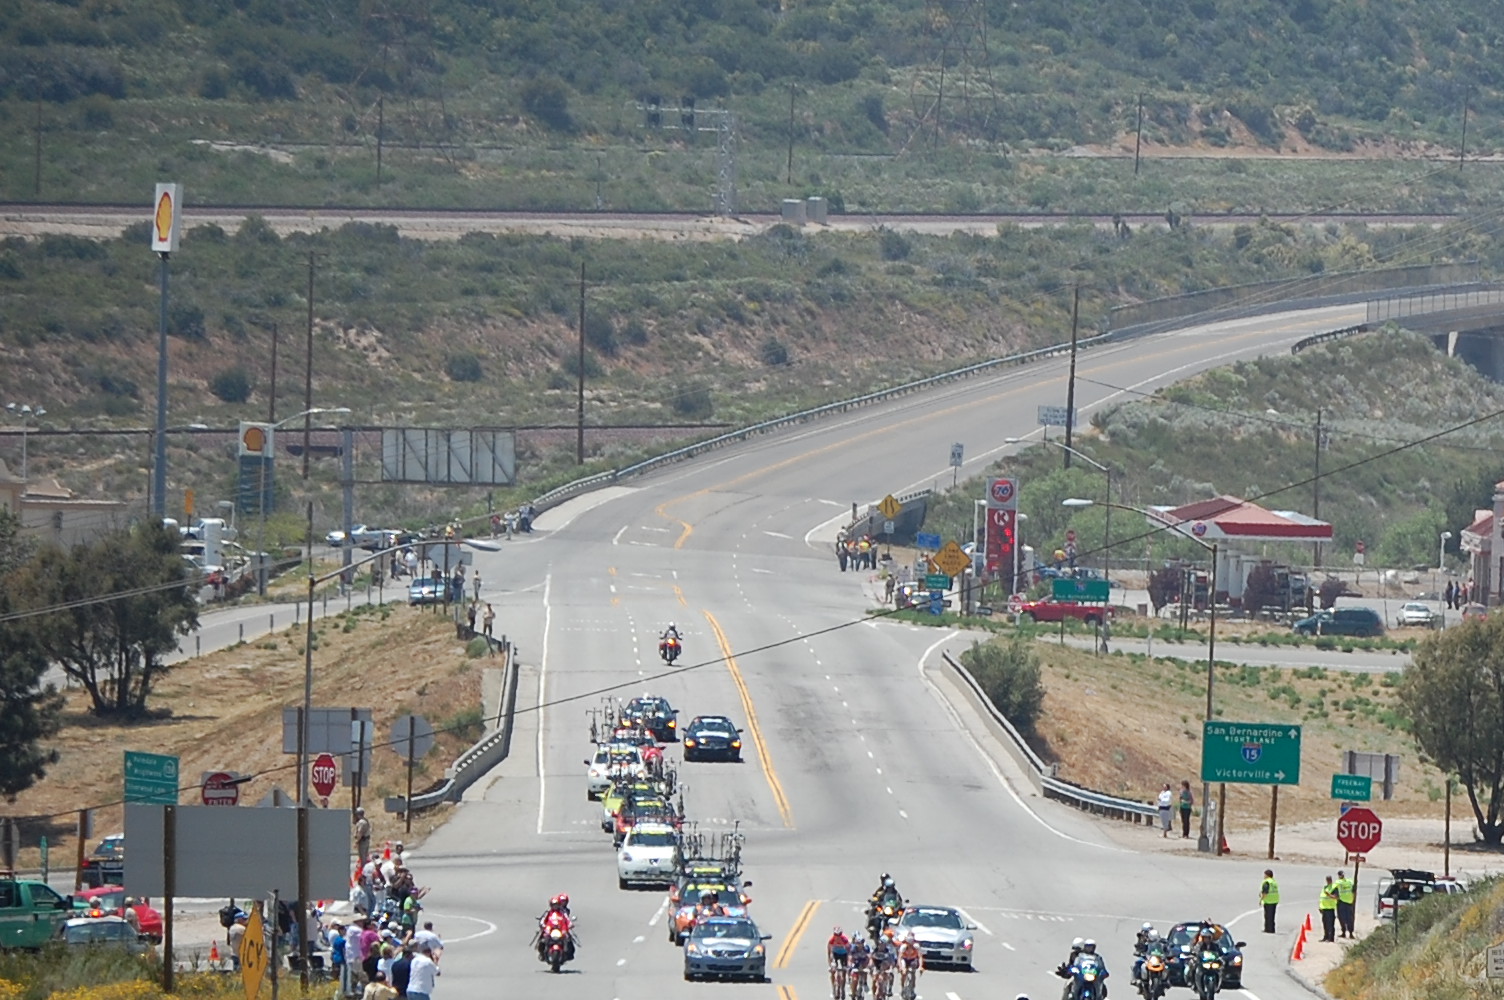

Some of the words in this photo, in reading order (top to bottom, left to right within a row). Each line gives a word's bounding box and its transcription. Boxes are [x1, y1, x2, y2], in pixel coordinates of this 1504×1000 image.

[994, 485, 1011, 498] 76
[1207, 726, 1225, 735] San
[1229, 726, 1283, 738] Bernardino
[1245, 749, 1258, 760] 15
[313, 767, 335, 784] STOP
[1216, 768, 1271, 779] Victorville
[1339, 821, 1380, 840] STOP
[242, 937, 264, 971] ICY
